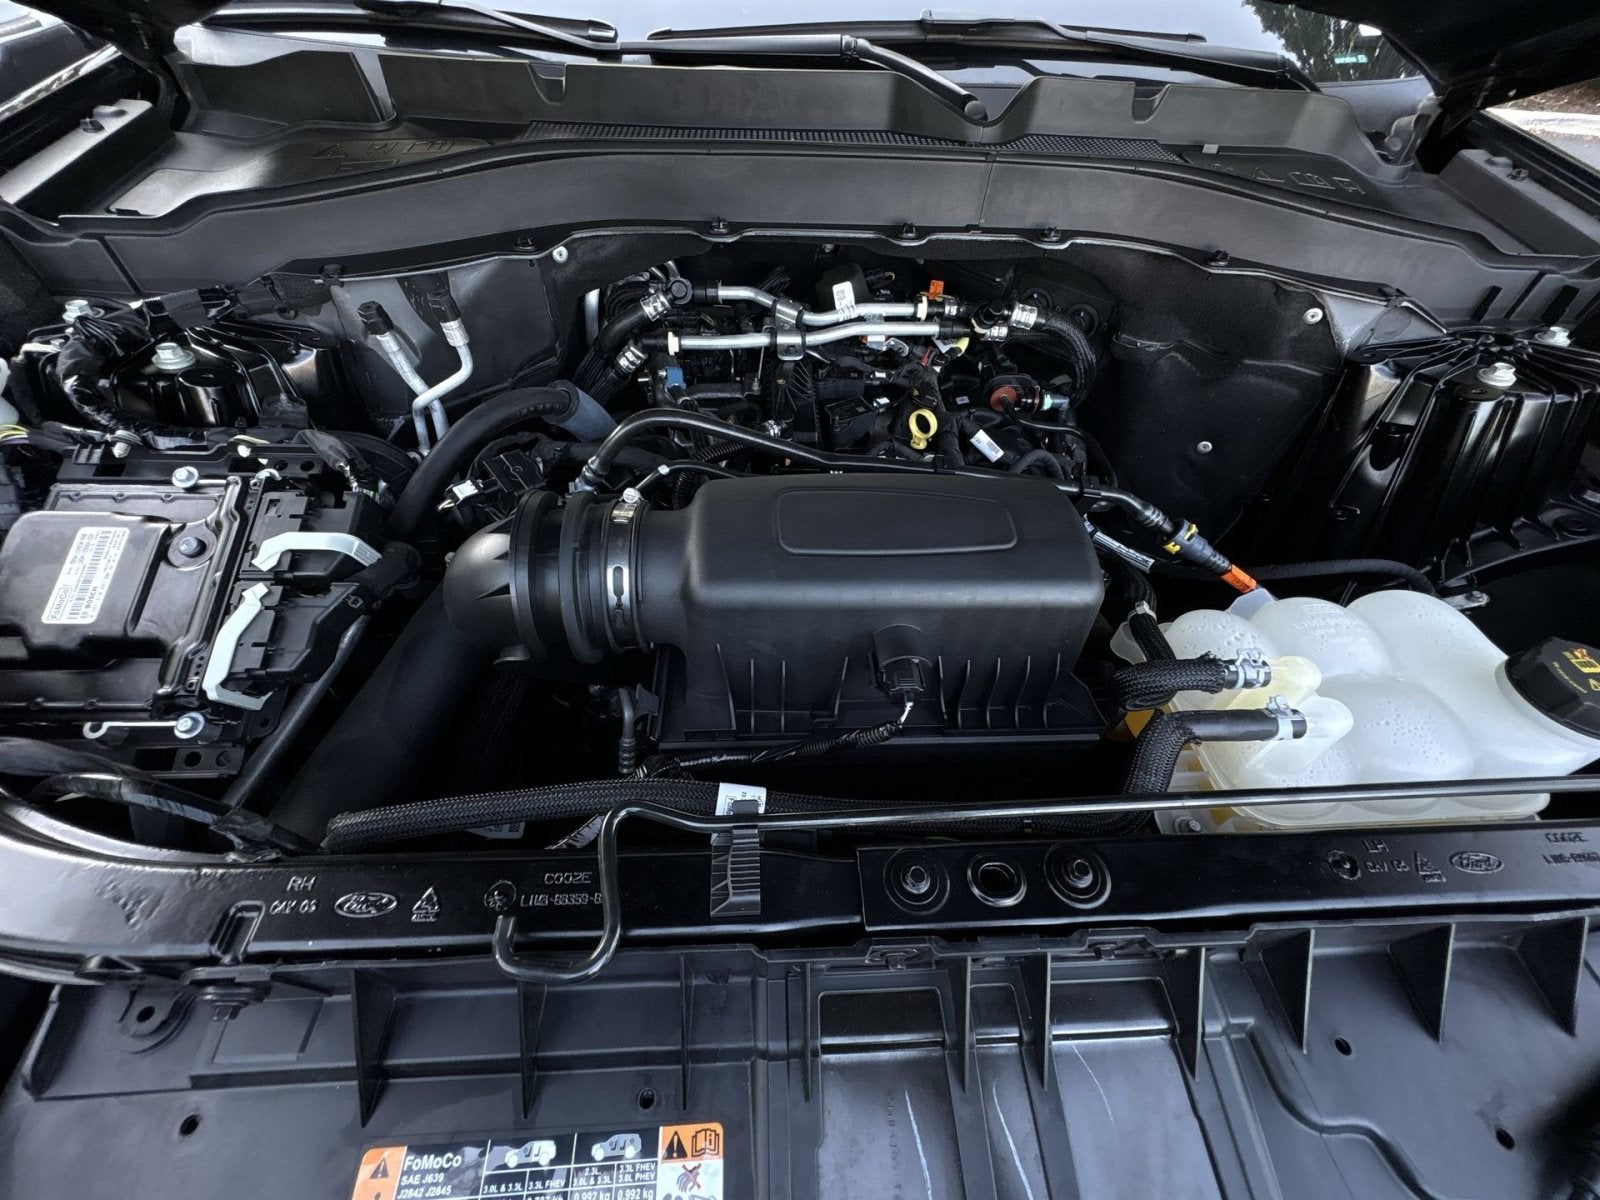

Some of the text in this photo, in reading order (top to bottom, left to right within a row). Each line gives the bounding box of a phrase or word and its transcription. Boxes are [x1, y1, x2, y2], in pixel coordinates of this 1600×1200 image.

[51, 588, 70, 620] FoMoCo
[85, 586, 98, 609] BOSCH
[286, 876, 316, 891] RH
[403, 1153, 462, 1171] FoMoCo
[635, 1162, 656, 1171] FHEV
[401, 1172, 445, 1186] SAE J639
[634, 1171, 656, 1181] PHEV
[483, 1184, 498, 1194] 3.0L
[508, 1182, 523, 1192] 3.3L
[528, 1179, 565, 1190] 3.3L FHEV
[397, 1185, 452, 1199] J2842 J2845
[617, 1187, 654, 1200] 0.992 kg
